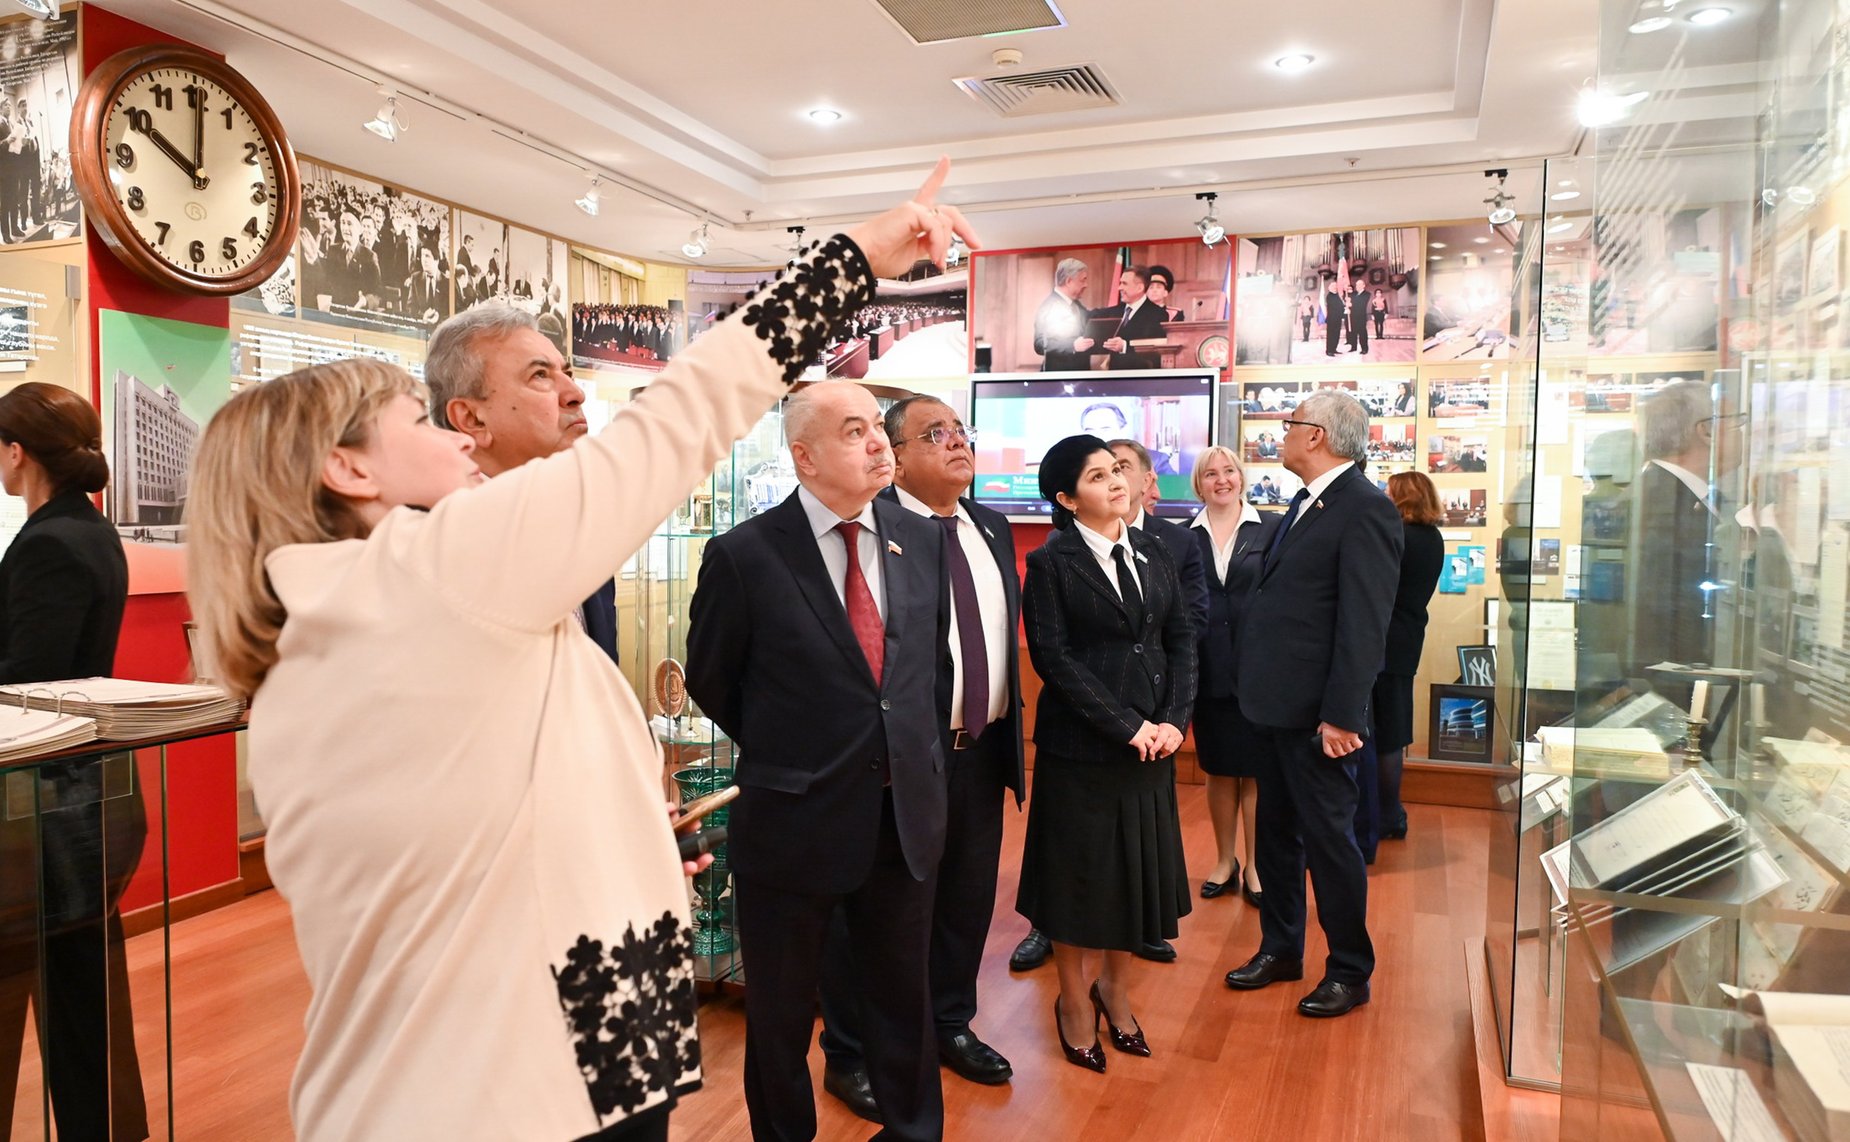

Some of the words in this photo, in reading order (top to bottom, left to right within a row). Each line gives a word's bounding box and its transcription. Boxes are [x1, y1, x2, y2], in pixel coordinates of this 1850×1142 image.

[149, 83, 172, 111] 11
[123, 106, 152, 134] 10
[220, 107, 232, 130] 1
[115, 143, 134, 169] 9
[244, 142, 259, 166] 2
[127, 185, 145, 211] 8
[250, 181, 268, 204] 3
[154, 221, 171, 245] 7
[244, 216, 259, 239] 4
[189, 240, 205, 263] 6
[222, 236, 237, 260] 5
